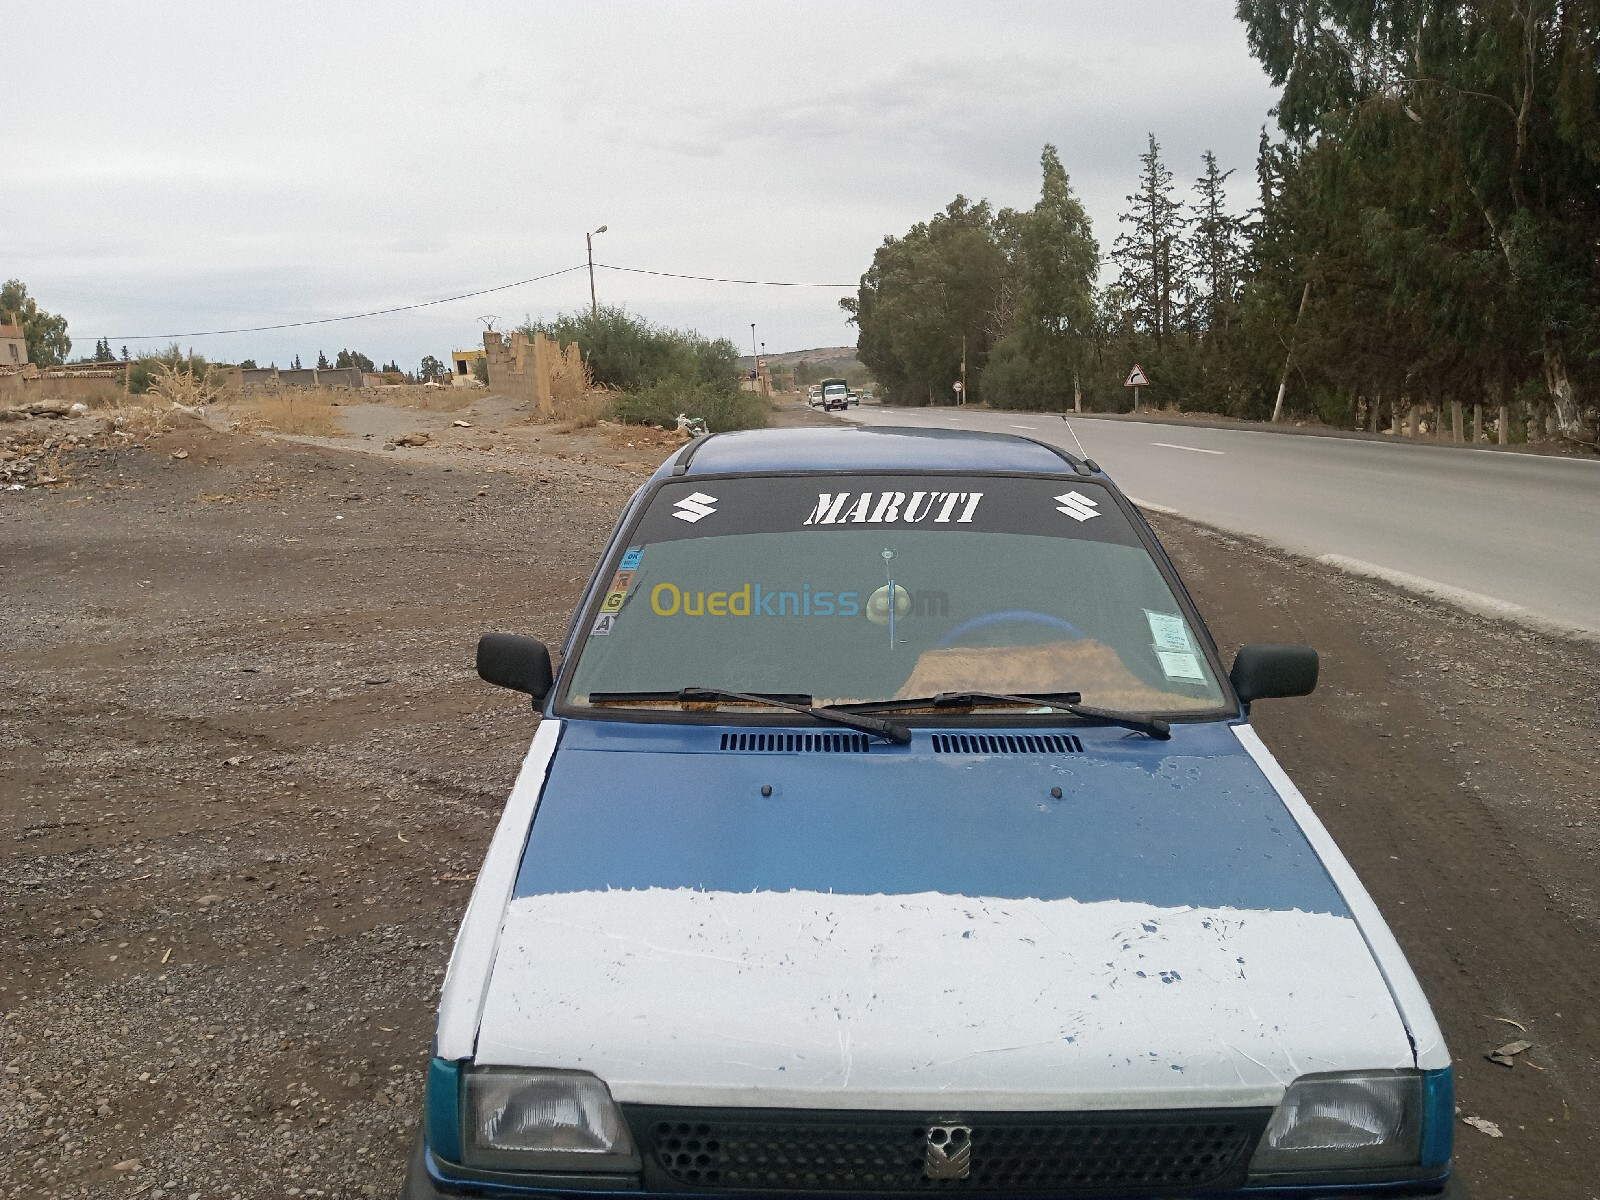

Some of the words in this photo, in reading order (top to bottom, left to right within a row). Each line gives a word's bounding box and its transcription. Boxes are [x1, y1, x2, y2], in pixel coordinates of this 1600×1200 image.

[803, 492, 984, 525] MARUTI
[608, 594, 622, 608] G
[596, 616, 610, 630] A
